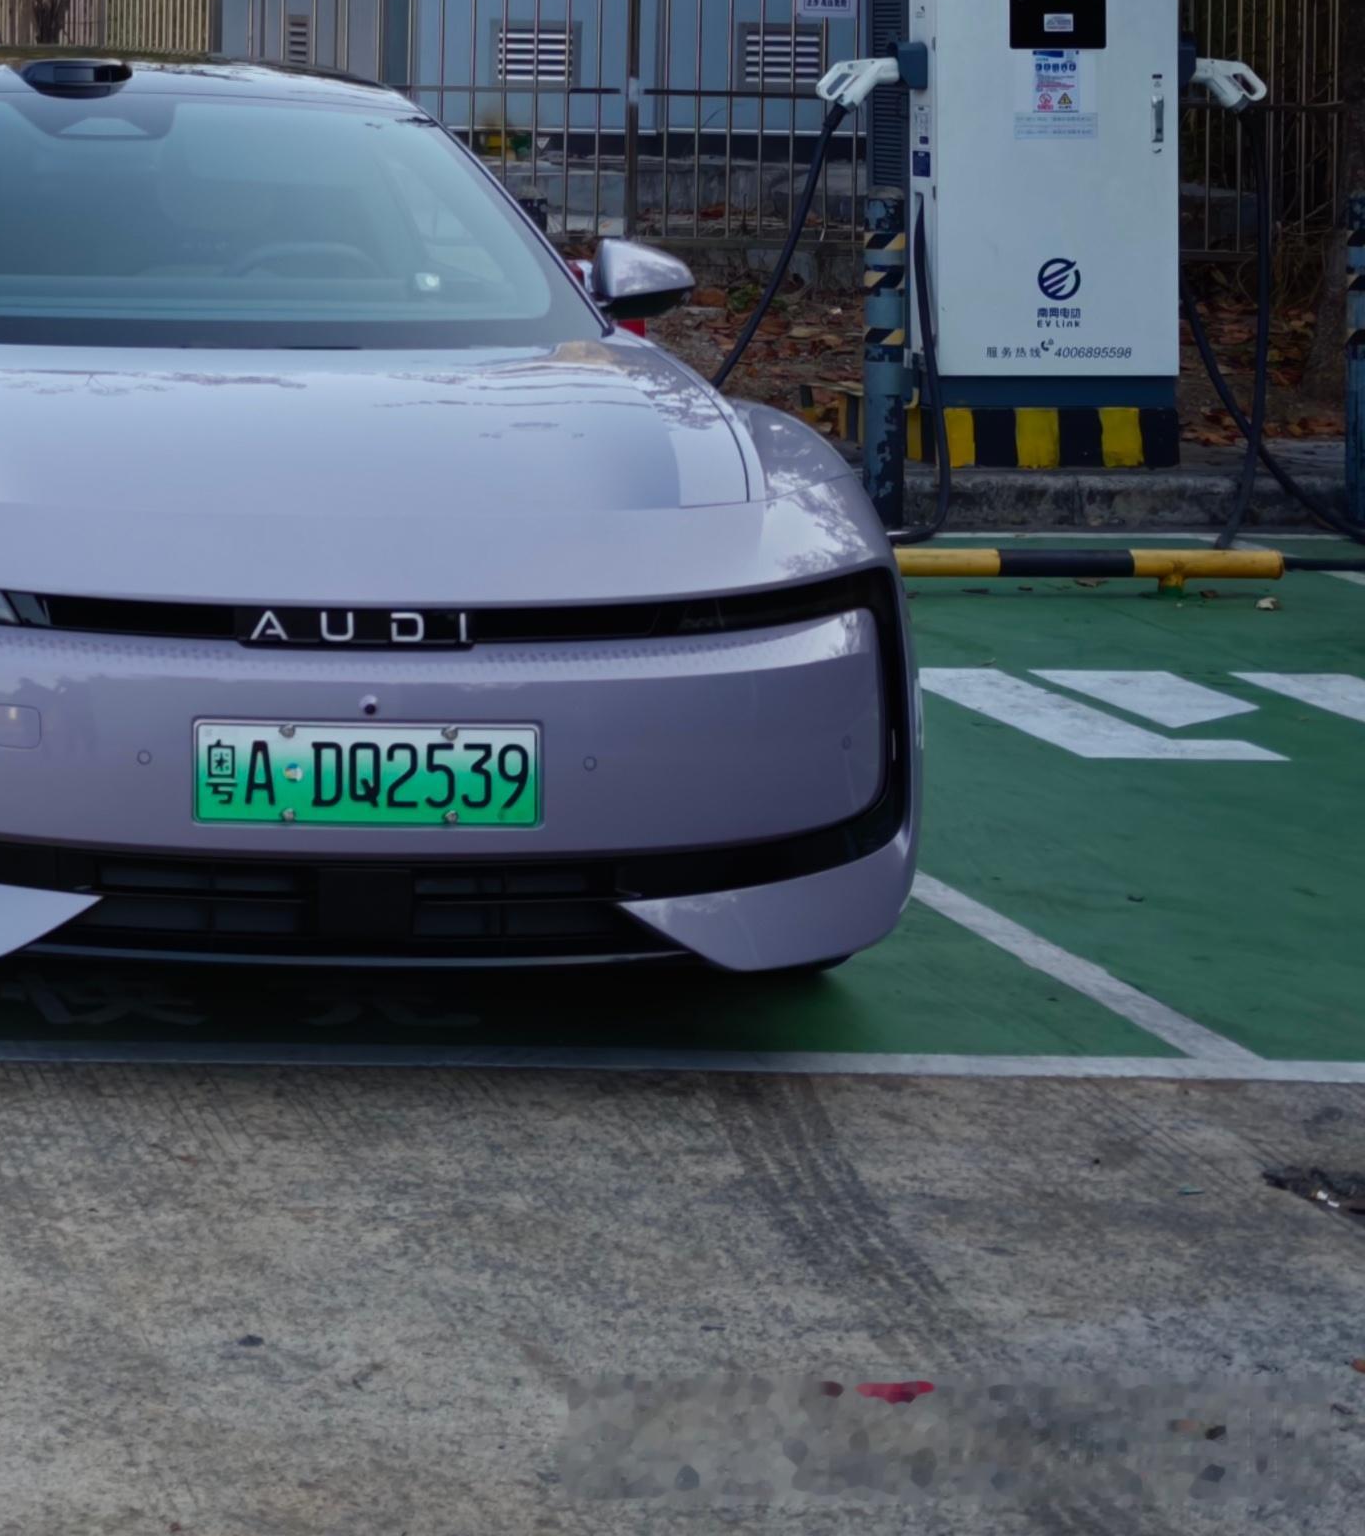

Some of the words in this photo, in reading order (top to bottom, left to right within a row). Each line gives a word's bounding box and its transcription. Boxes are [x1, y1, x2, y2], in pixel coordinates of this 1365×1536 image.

[1036, 307, 1081, 319] 南网电动
[1036, 320, 1052, 328] EV
[1055, 320, 1081, 328] Link
[985, 346, 1042, 359] 服务热线
[1054, 346, 1132, 359] 4006895598
[249, 609, 469, 644] AUDI
